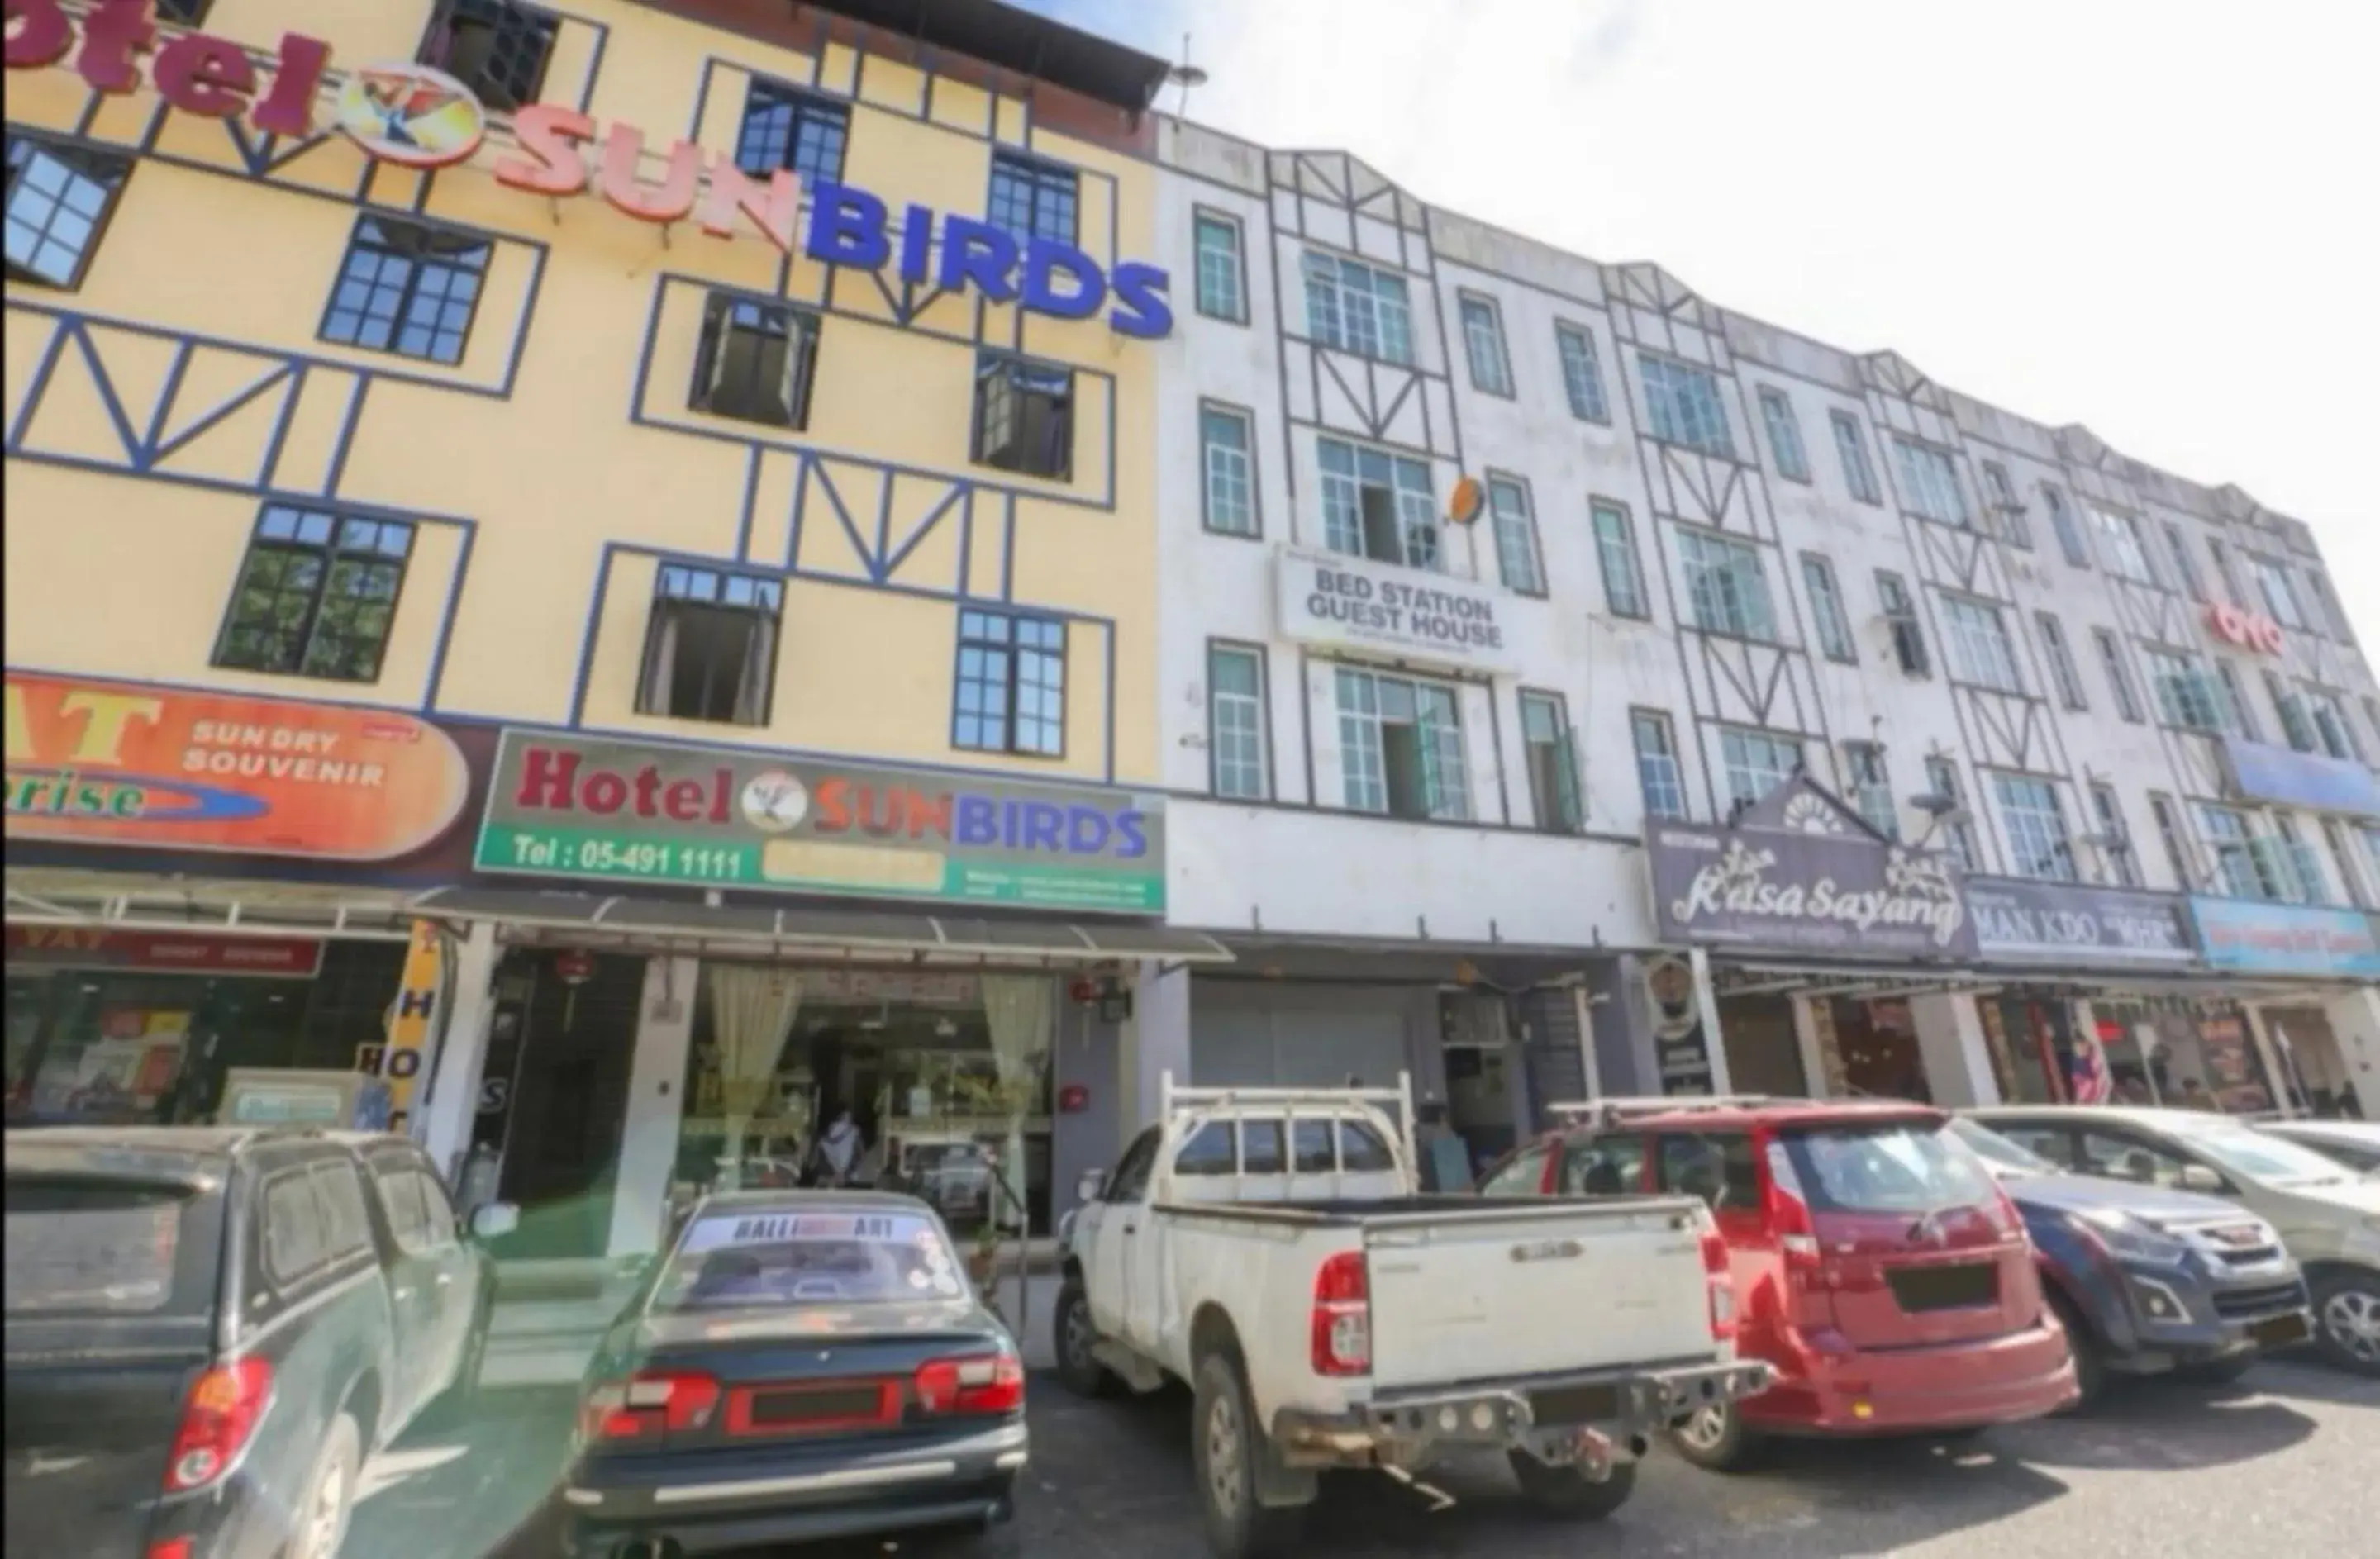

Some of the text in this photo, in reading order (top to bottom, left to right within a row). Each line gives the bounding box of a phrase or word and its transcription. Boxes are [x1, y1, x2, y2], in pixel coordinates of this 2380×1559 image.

[1307, 593, 1402, 630] GUEST
[1409, 611, 1503, 649] HOUSE
[1316, 569, 1492, 622] BED STATION
[191, 717, 340, 753] SUNDRY
[182, 747, 386, 786] SOUVENIR
[515, 746, 734, 825] Hotel
[579, 839, 671, 874] 05-491
[680, 847, 741, 879] 1111
[1806, 877, 1962, 948] Sayang
